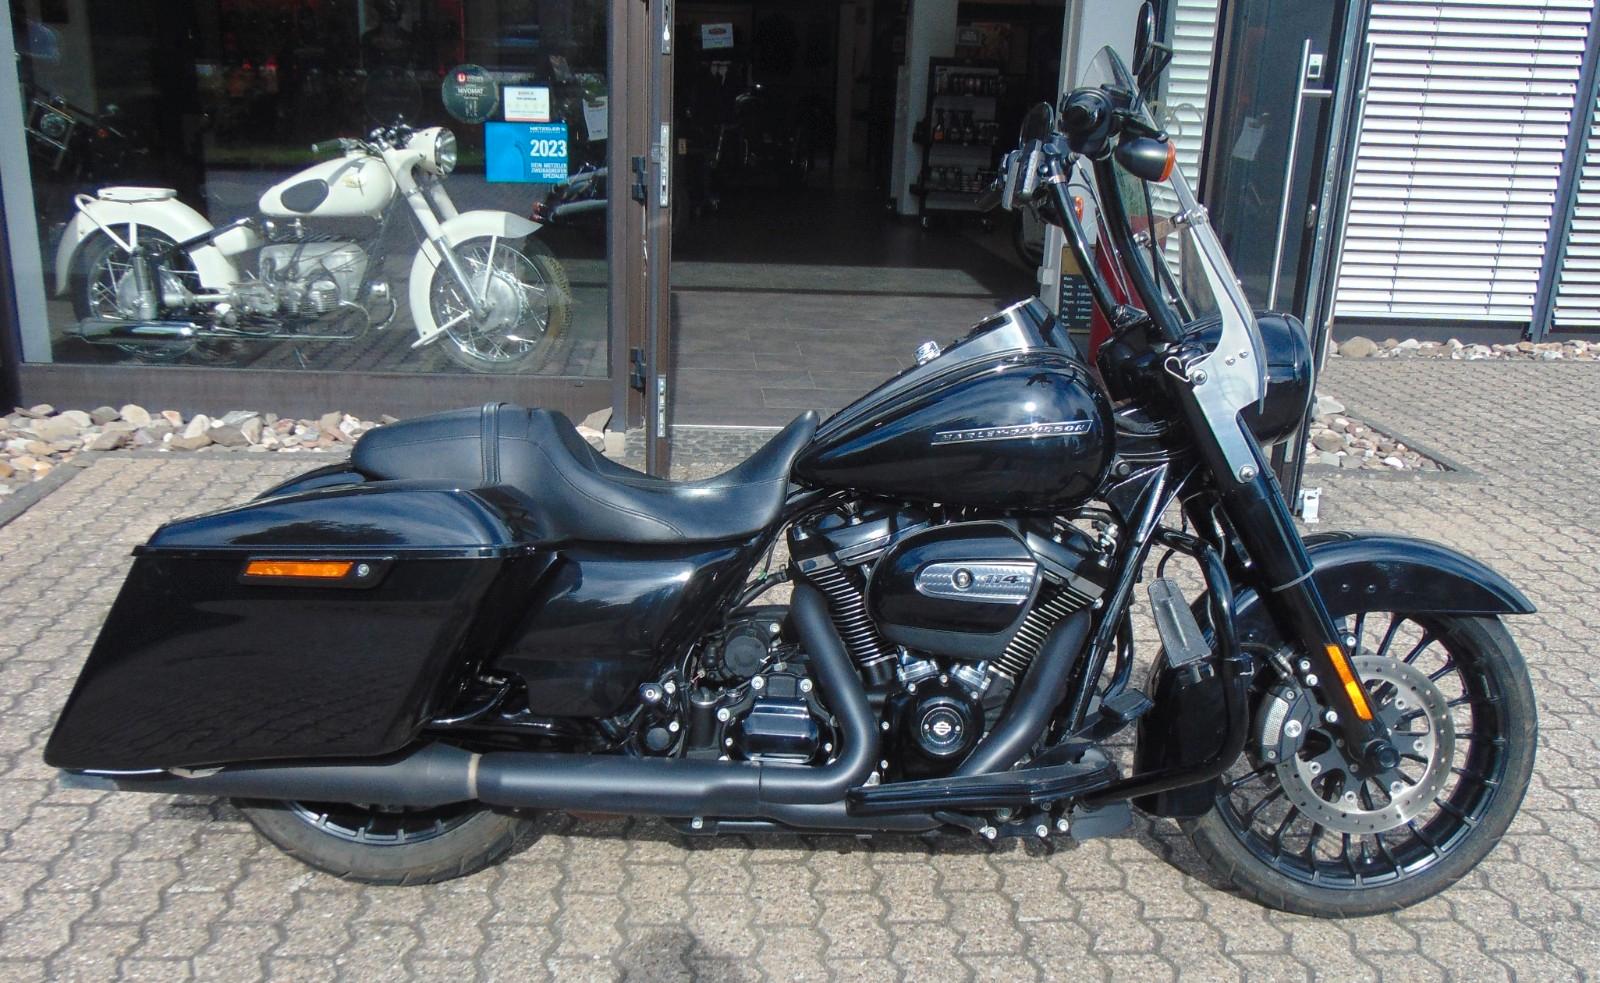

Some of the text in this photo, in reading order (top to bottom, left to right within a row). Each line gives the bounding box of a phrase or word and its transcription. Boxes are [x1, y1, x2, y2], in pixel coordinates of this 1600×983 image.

[530, 139, 567, 157] 2023
[941, 423, 1086, 441] HARLEY-DAVIDSON
[983, 573, 1019, 584] 114
